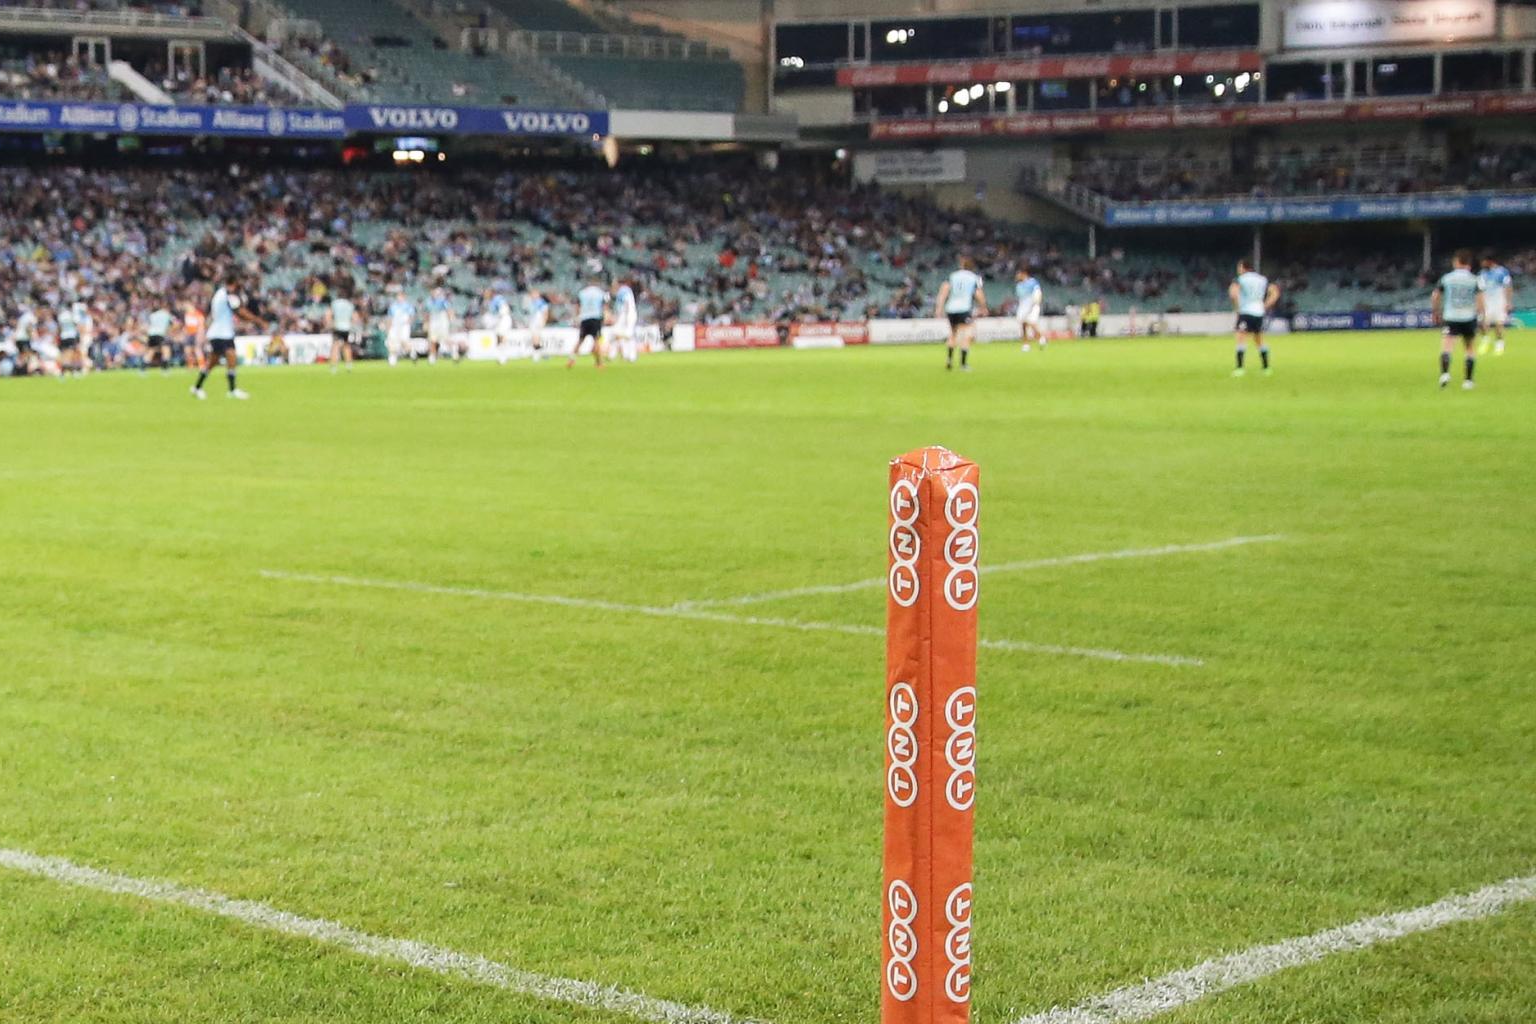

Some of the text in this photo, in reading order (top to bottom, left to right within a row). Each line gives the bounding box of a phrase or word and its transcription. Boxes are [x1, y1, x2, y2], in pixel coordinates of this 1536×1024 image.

[61, 105, 201, 128] Allianz Stadium
[213, 107, 345, 131] Allianz Stadium
[369, 107, 458, 129] VOLVO
[502, 111, 590, 132] VOLVO
[893, 485, 917, 600] TNT
[949, 489, 975, 604] TNT
[891, 688, 914, 801] TNT
[950, 692, 974, 805] TNT
[891, 886, 912, 993] TNT
[950, 889, 970, 997] TNT
